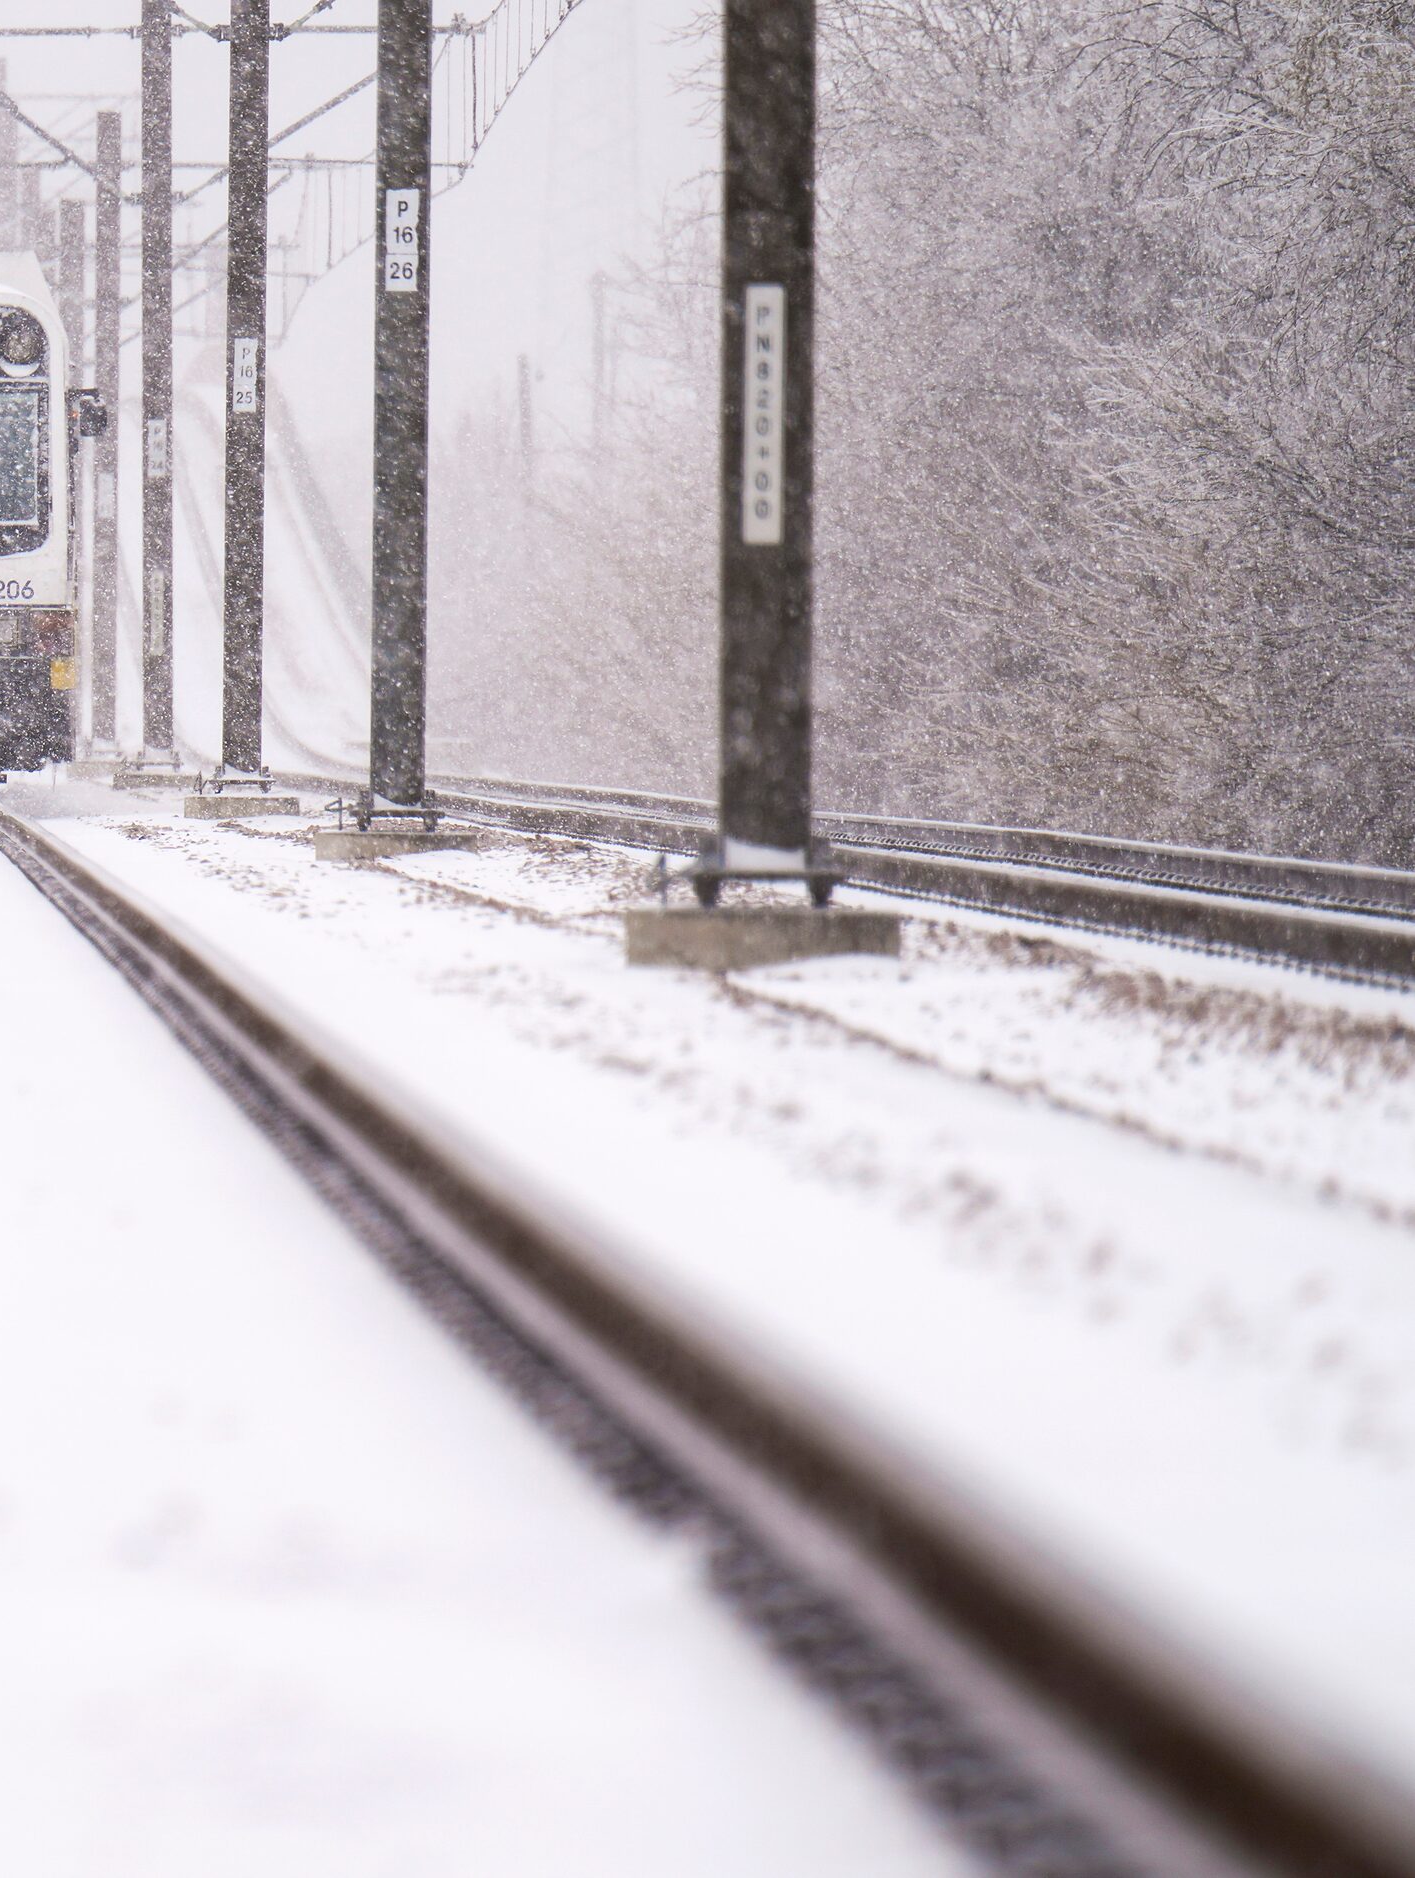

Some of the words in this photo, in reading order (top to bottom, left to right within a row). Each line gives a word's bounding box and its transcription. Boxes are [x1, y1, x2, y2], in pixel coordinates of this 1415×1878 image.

[398, 201, 408, 217] P
[393, 226, 413, 243] 16
[390, 262, 413, 279] 26
[242, 347, 250, 359] P
[240, 365, 253, 377] 16
[236, 391, 252, 404] 25
